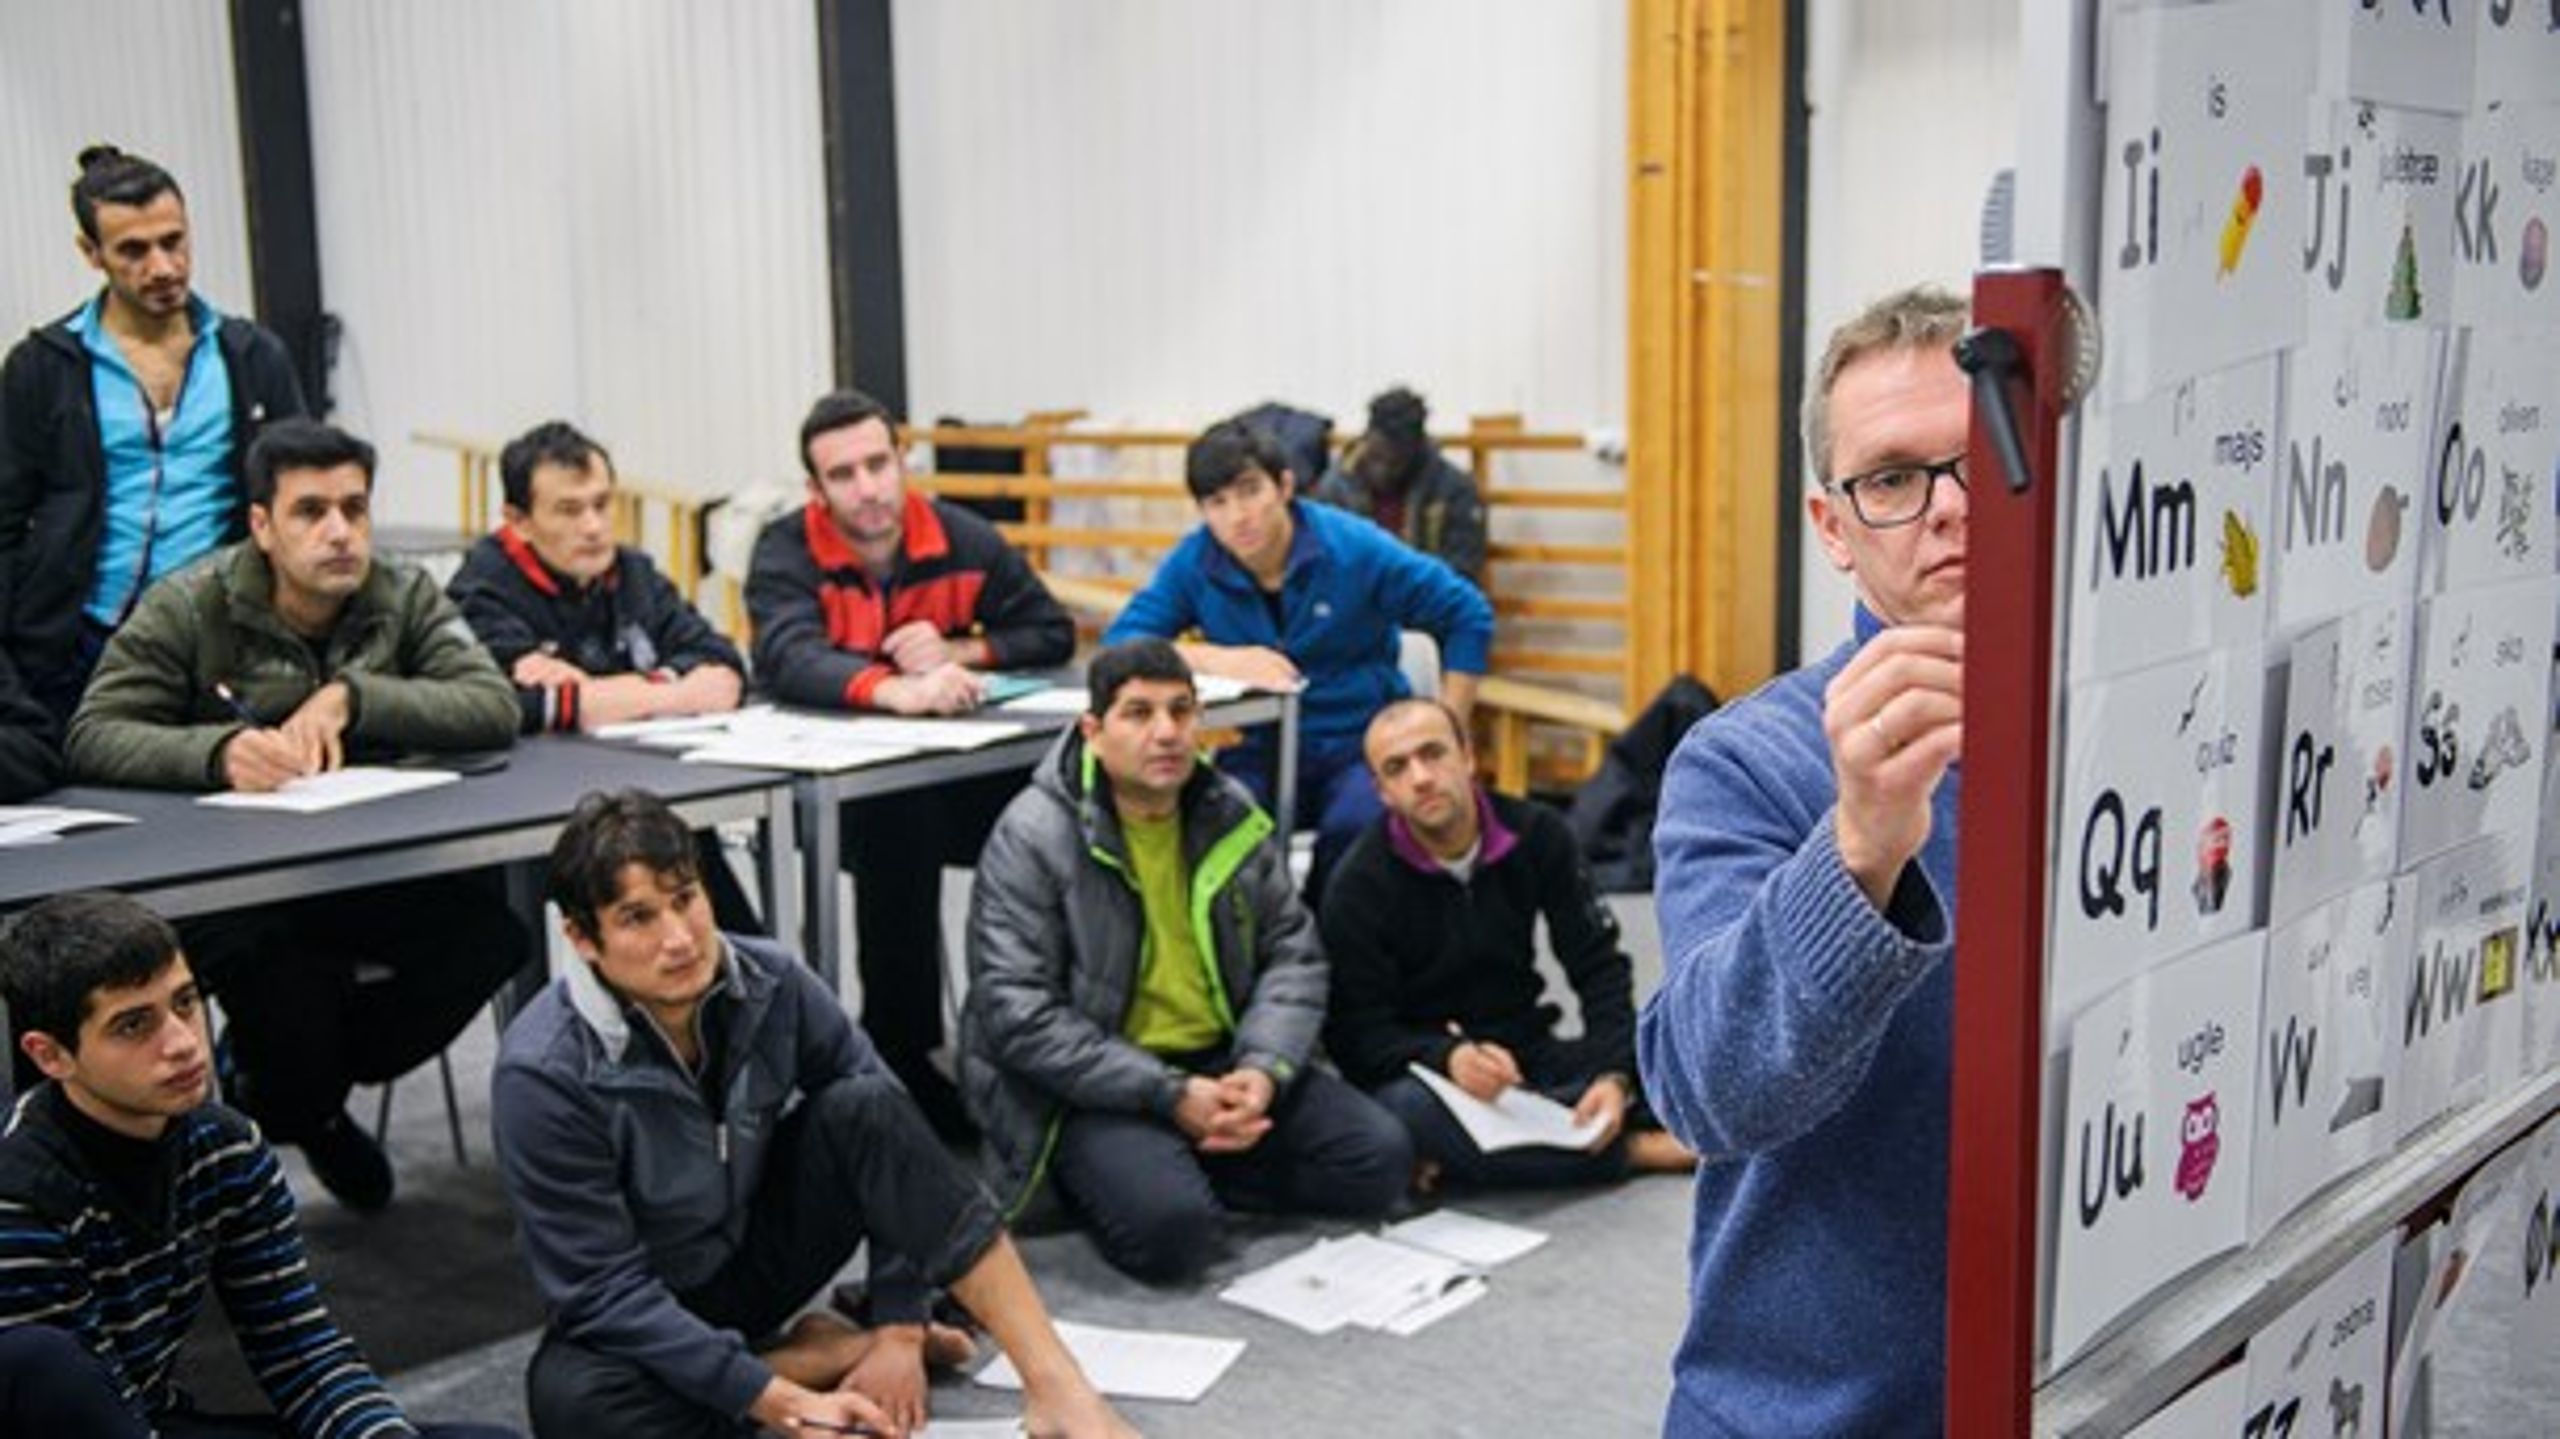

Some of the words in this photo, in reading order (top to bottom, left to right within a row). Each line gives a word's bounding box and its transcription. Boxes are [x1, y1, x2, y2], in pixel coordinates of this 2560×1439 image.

[2302, 146, 2352, 292] Jj
[2090, 458, 2196, 594] Mm
[2286, 434, 2347, 554] Nn
[2438, 421, 2486, 527] Oo
[2286, 728, 2335, 849] Rr
[2416, 690, 2461, 788] Ss
[2080, 787, 2163, 932] Qq
[2177, 1020, 2225, 1076] ugle
[2270, 1014, 2318, 1127] Vv
[2079, 1101, 2145, 1230] Uu
